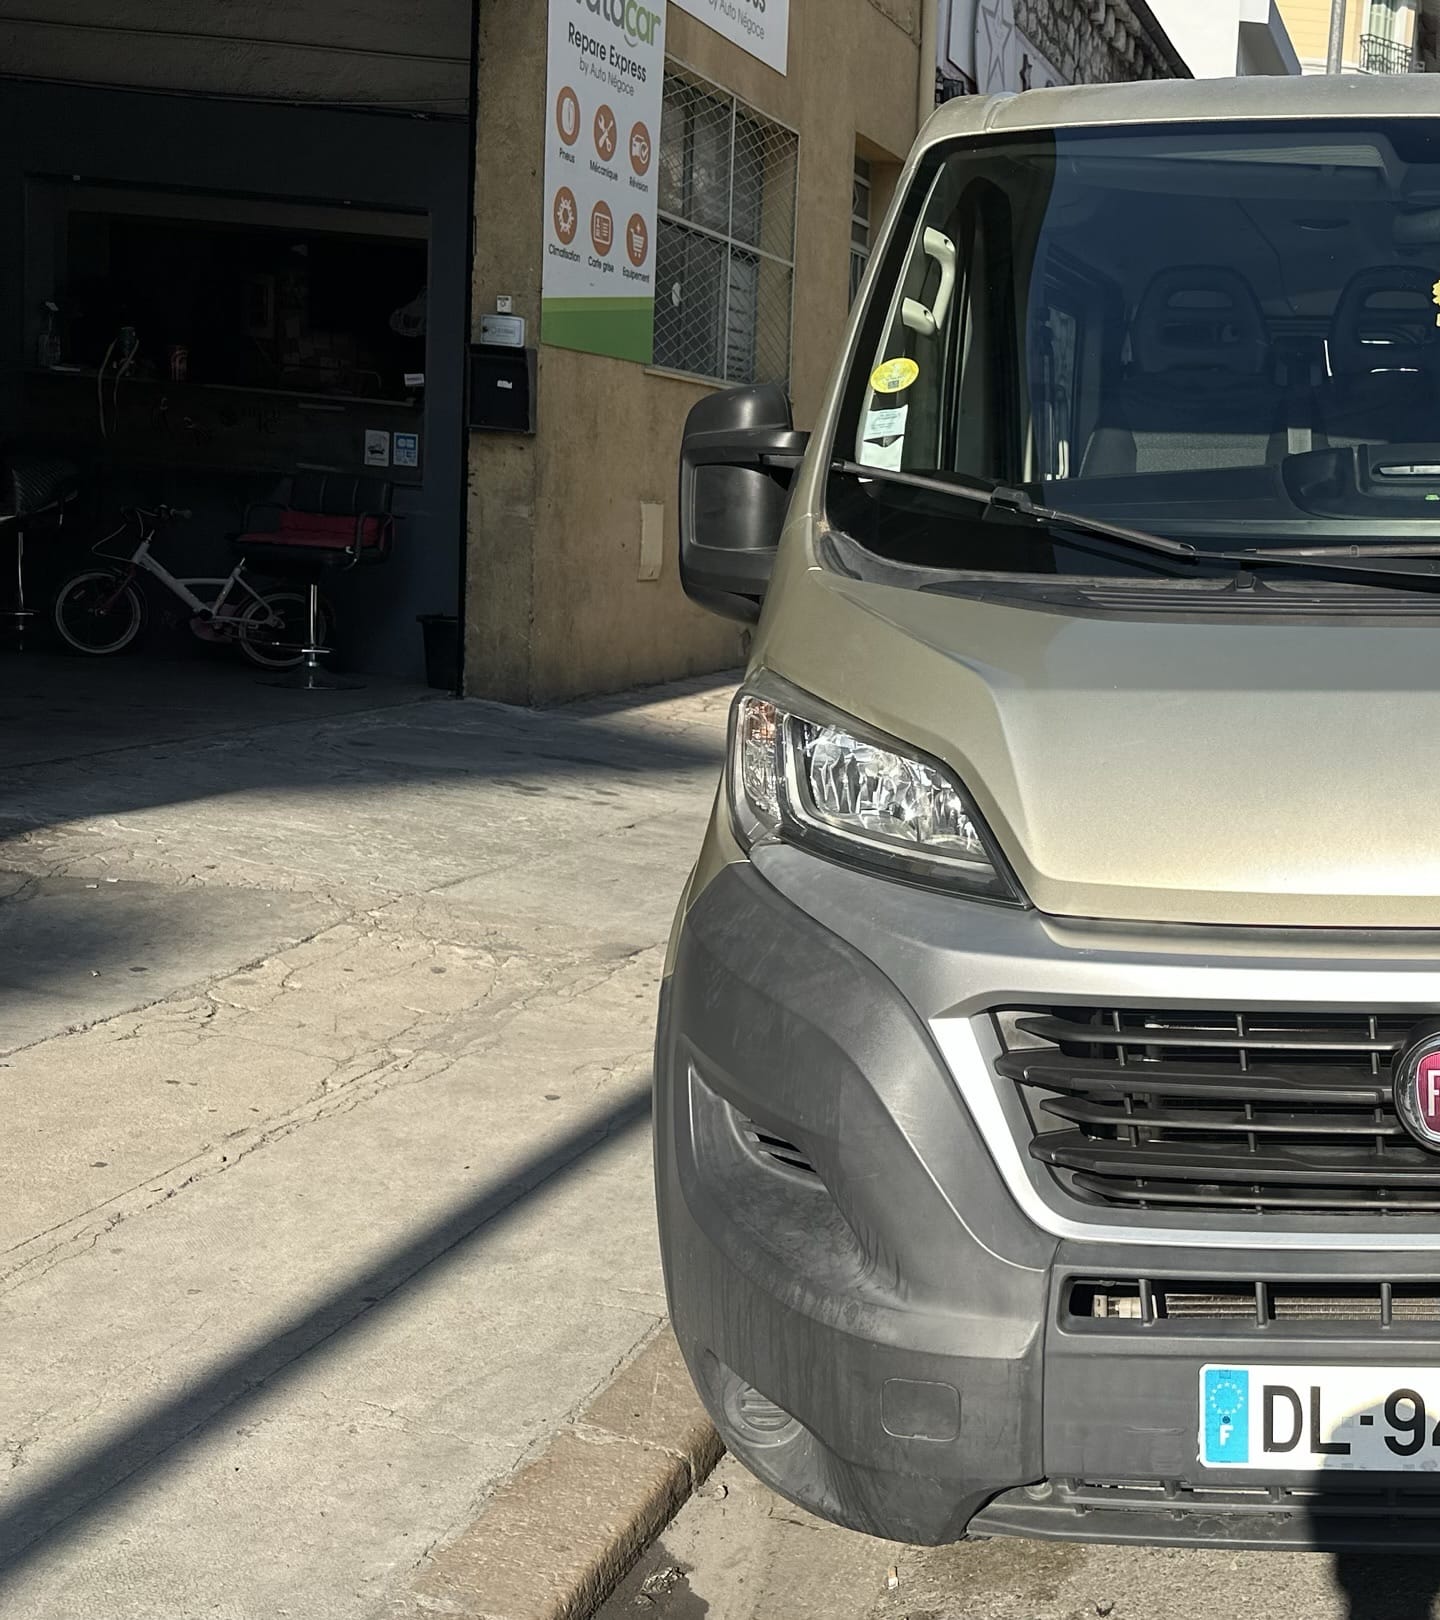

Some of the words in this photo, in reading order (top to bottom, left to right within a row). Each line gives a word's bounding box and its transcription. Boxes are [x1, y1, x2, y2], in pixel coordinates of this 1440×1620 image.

[719, 1, 737, 20] Auto
[737, 8, 765, 40] Négoce
[568, 21, 607, 61] Repare
[609, 44, 647, 83] Express
[579, 57, 589, 76] by
[590, 63, 607, 82] Auto
[607, 71, 635, 97] Négoce
[1220, 1424, 1234, 1447] F
